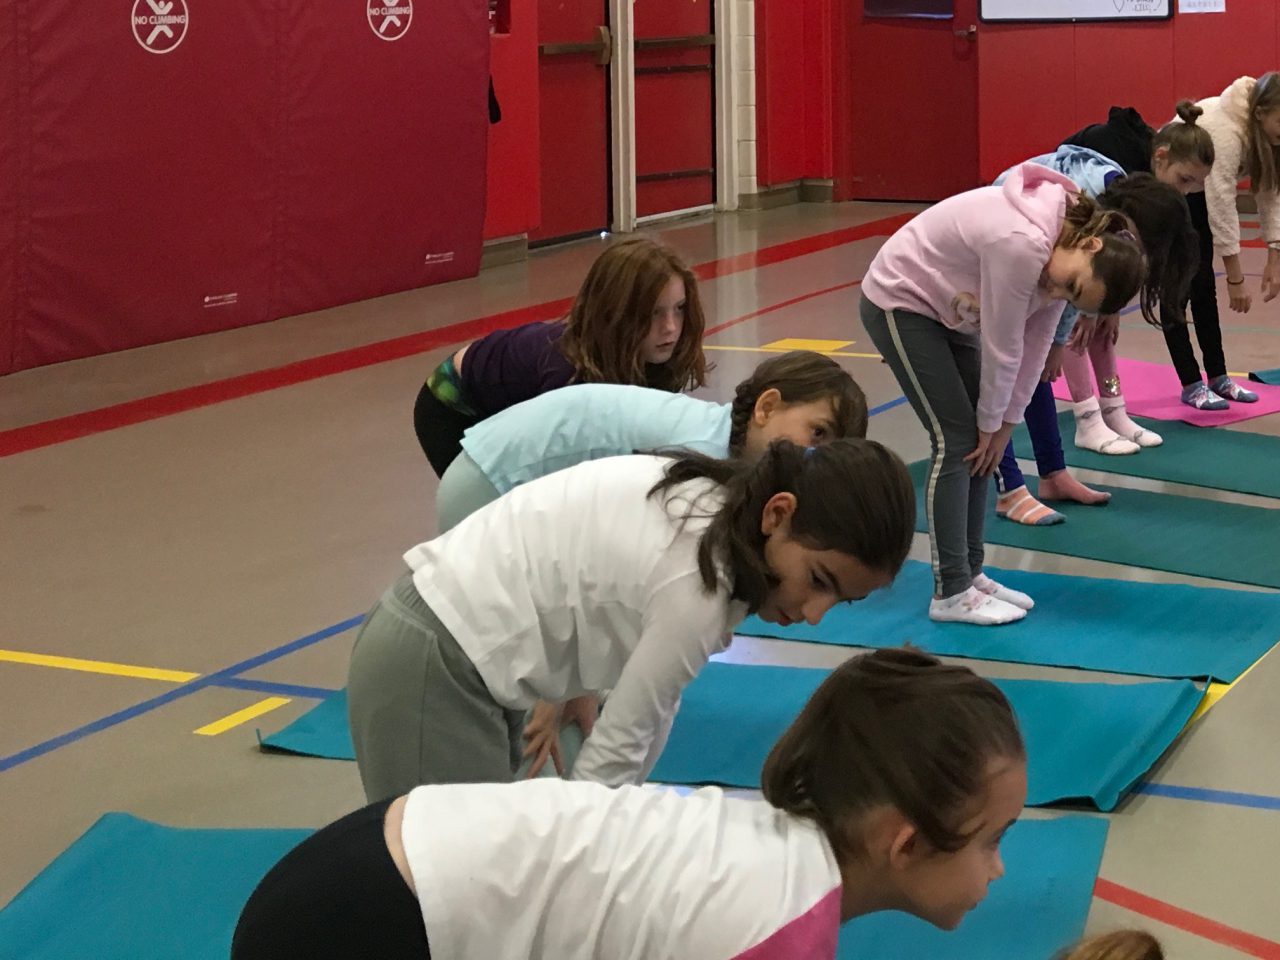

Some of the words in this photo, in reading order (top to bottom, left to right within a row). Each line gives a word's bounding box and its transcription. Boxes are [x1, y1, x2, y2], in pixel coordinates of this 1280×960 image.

[369, 8, 380, 16] NO
[380, 6, 411, 16] CLIMBING
[134, 16, 148, 25] NO
[149, 15, 186, 25] CLIMBING
